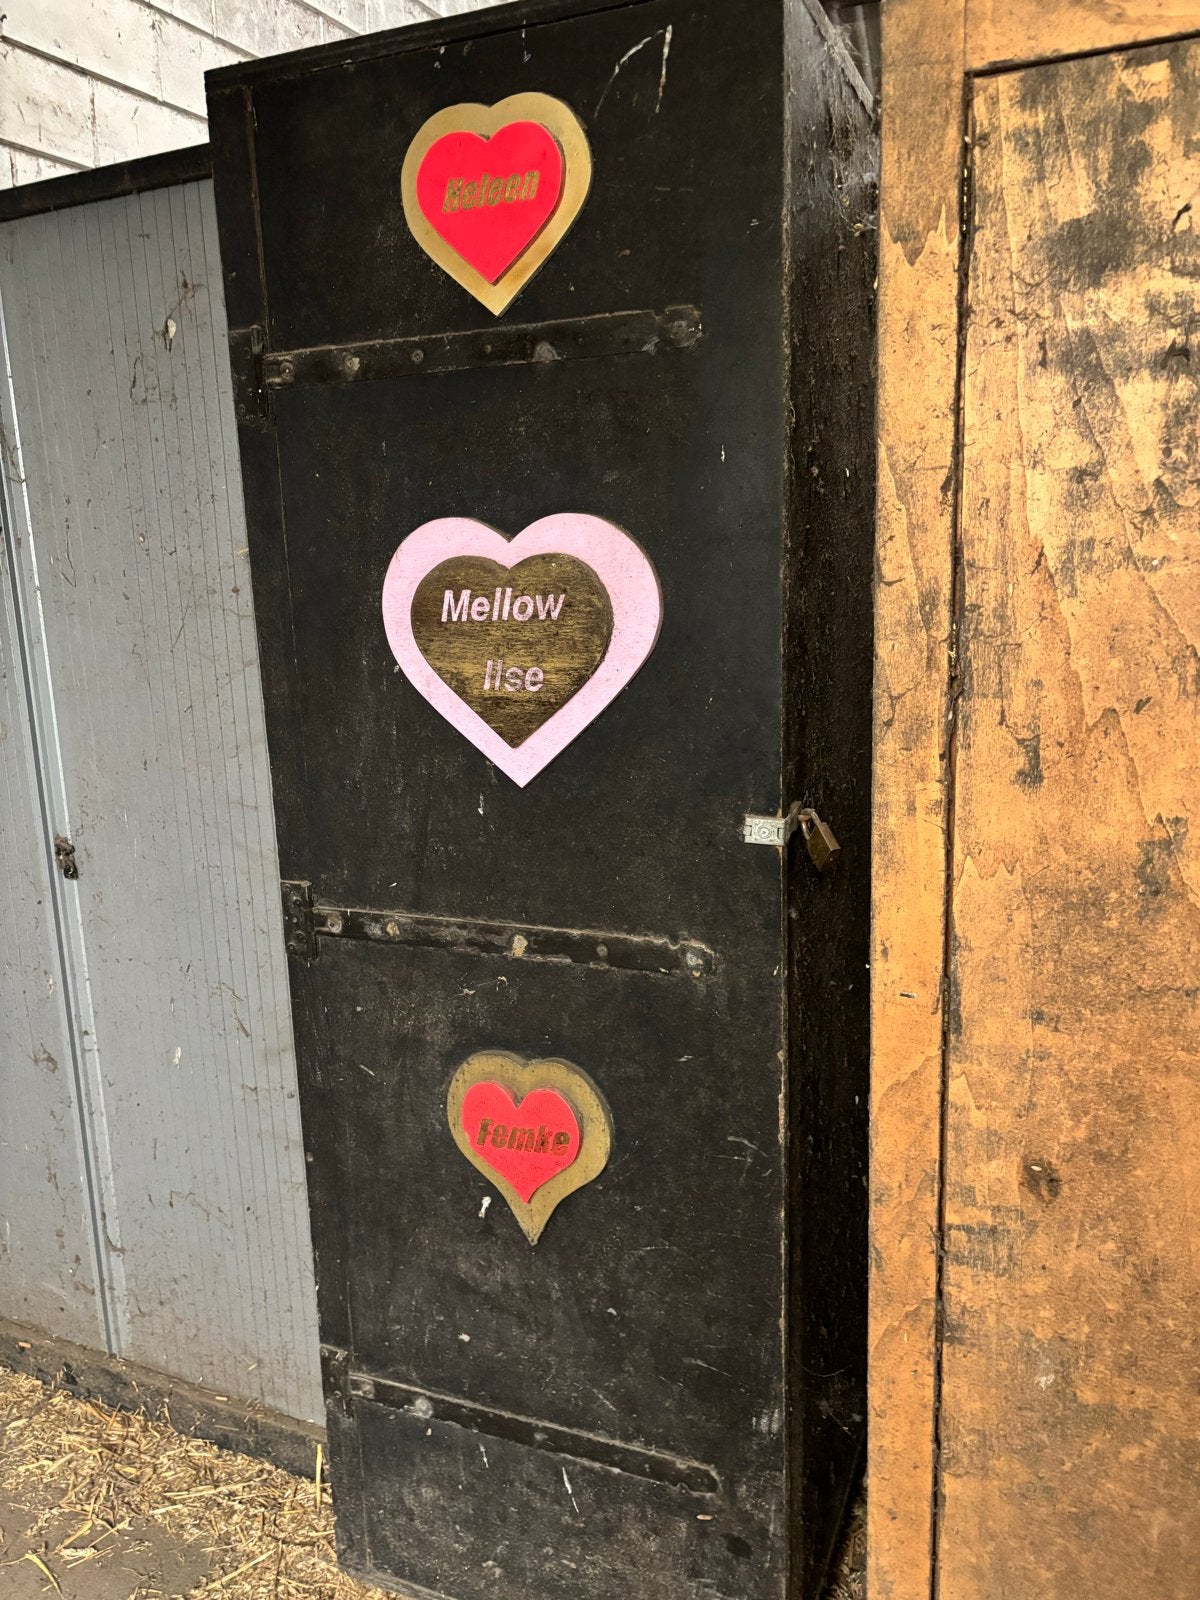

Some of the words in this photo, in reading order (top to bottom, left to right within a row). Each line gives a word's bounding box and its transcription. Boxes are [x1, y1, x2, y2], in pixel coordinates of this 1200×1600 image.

[443, 170, 540, 213] Heleen
[440, 587, 566, 622] Mellow
[483, 659, 544, 692] Ilse
[476, 1118, 570, 1156] Femke
